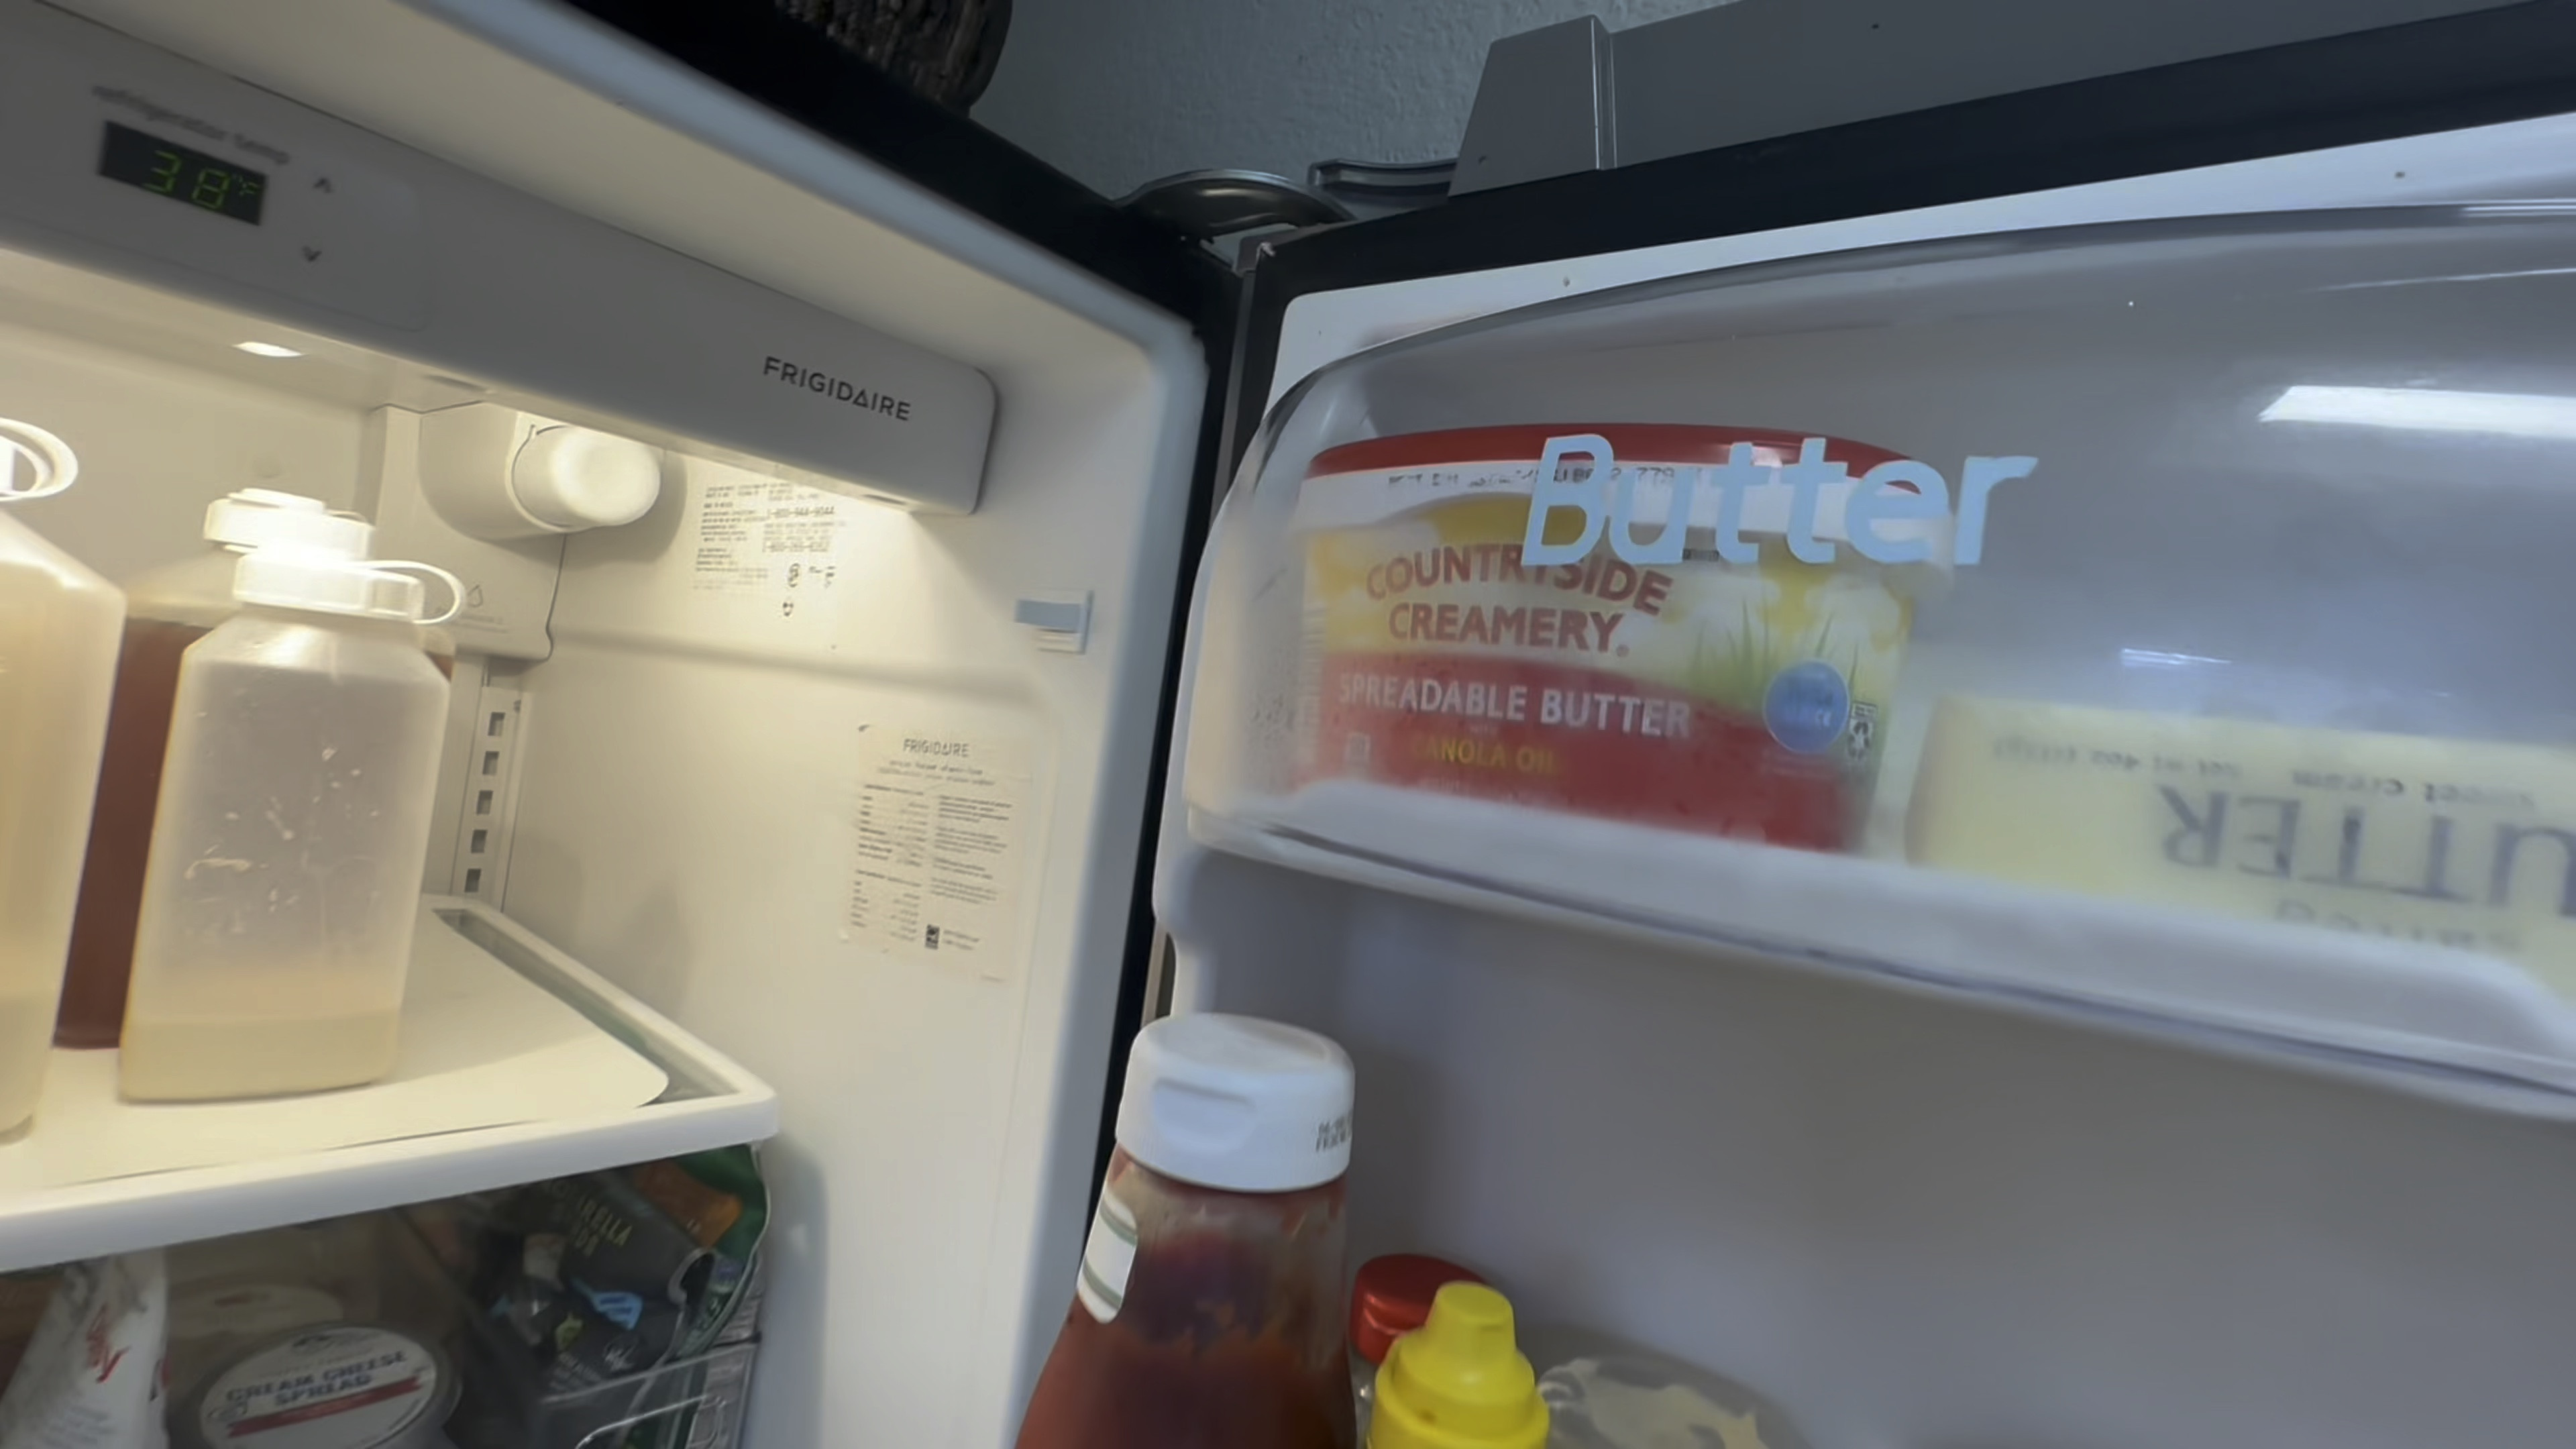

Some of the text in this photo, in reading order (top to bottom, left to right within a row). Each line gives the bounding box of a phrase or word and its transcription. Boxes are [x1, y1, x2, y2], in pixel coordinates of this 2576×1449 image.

[763, 356, 912, 421] FRIGIDAIRE
[1521, 434, 2039, 566] Butter
[1388, 602, 1623, 653] CREAMERY
[1340, 672, 1692, 739] SPREADABLE BUTTER
[903, 738, 971, 758] FRIGIDAIRE
[2155, 783, 2576, 918] UTTER
[227, 1372, 315, 1402] CREAM
[322, 1349, 407, 1381] CHEESE
[275, 1373, 372, 1406] SPREAD
